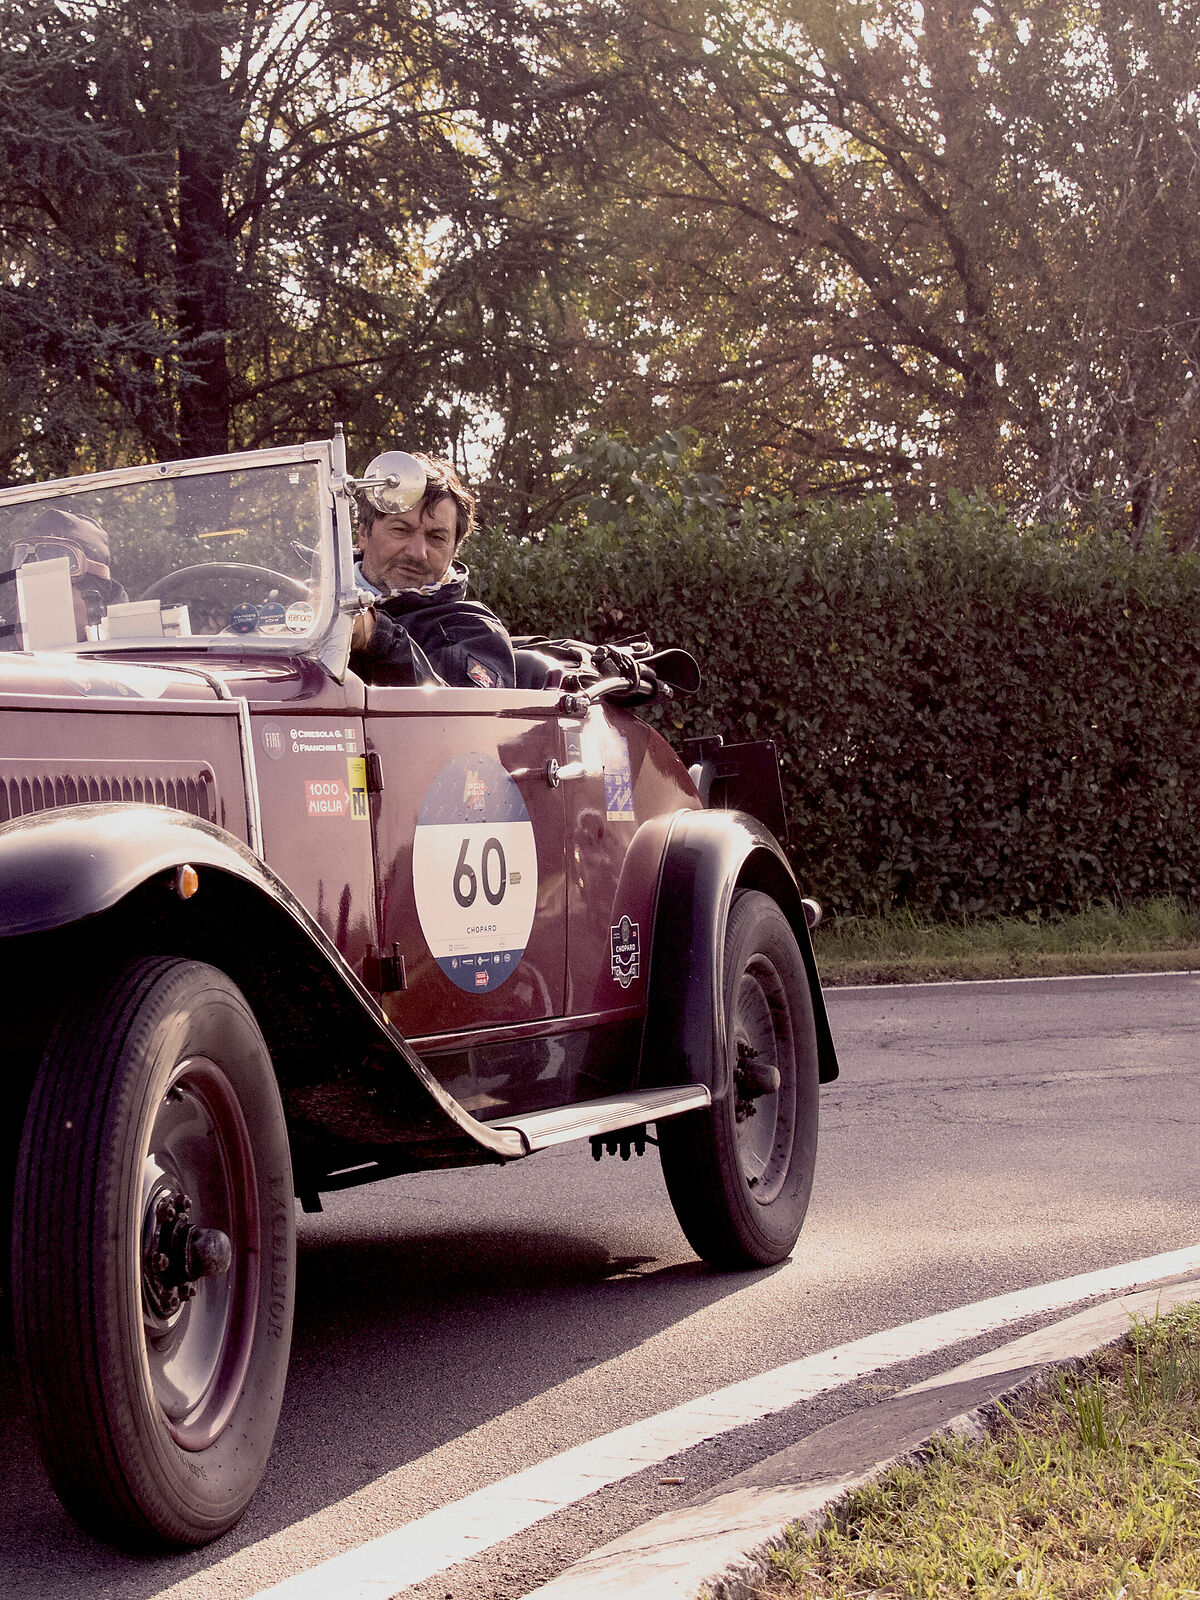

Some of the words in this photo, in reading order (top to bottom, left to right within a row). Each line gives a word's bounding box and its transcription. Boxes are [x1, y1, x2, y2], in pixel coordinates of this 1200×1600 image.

[334, 730, 343, 738] G.
[265, 732, 280, 748] FIAT
[337, 743, 344, 751] S.
[309, 783, 339, 795] 1000
[309, 800, 343, 812] MIGLIA
[453, 837, 507, 908] 60
[466, 925, 497, 934] CHOPARD
[615, 944, 636, 953] CHOPARD
